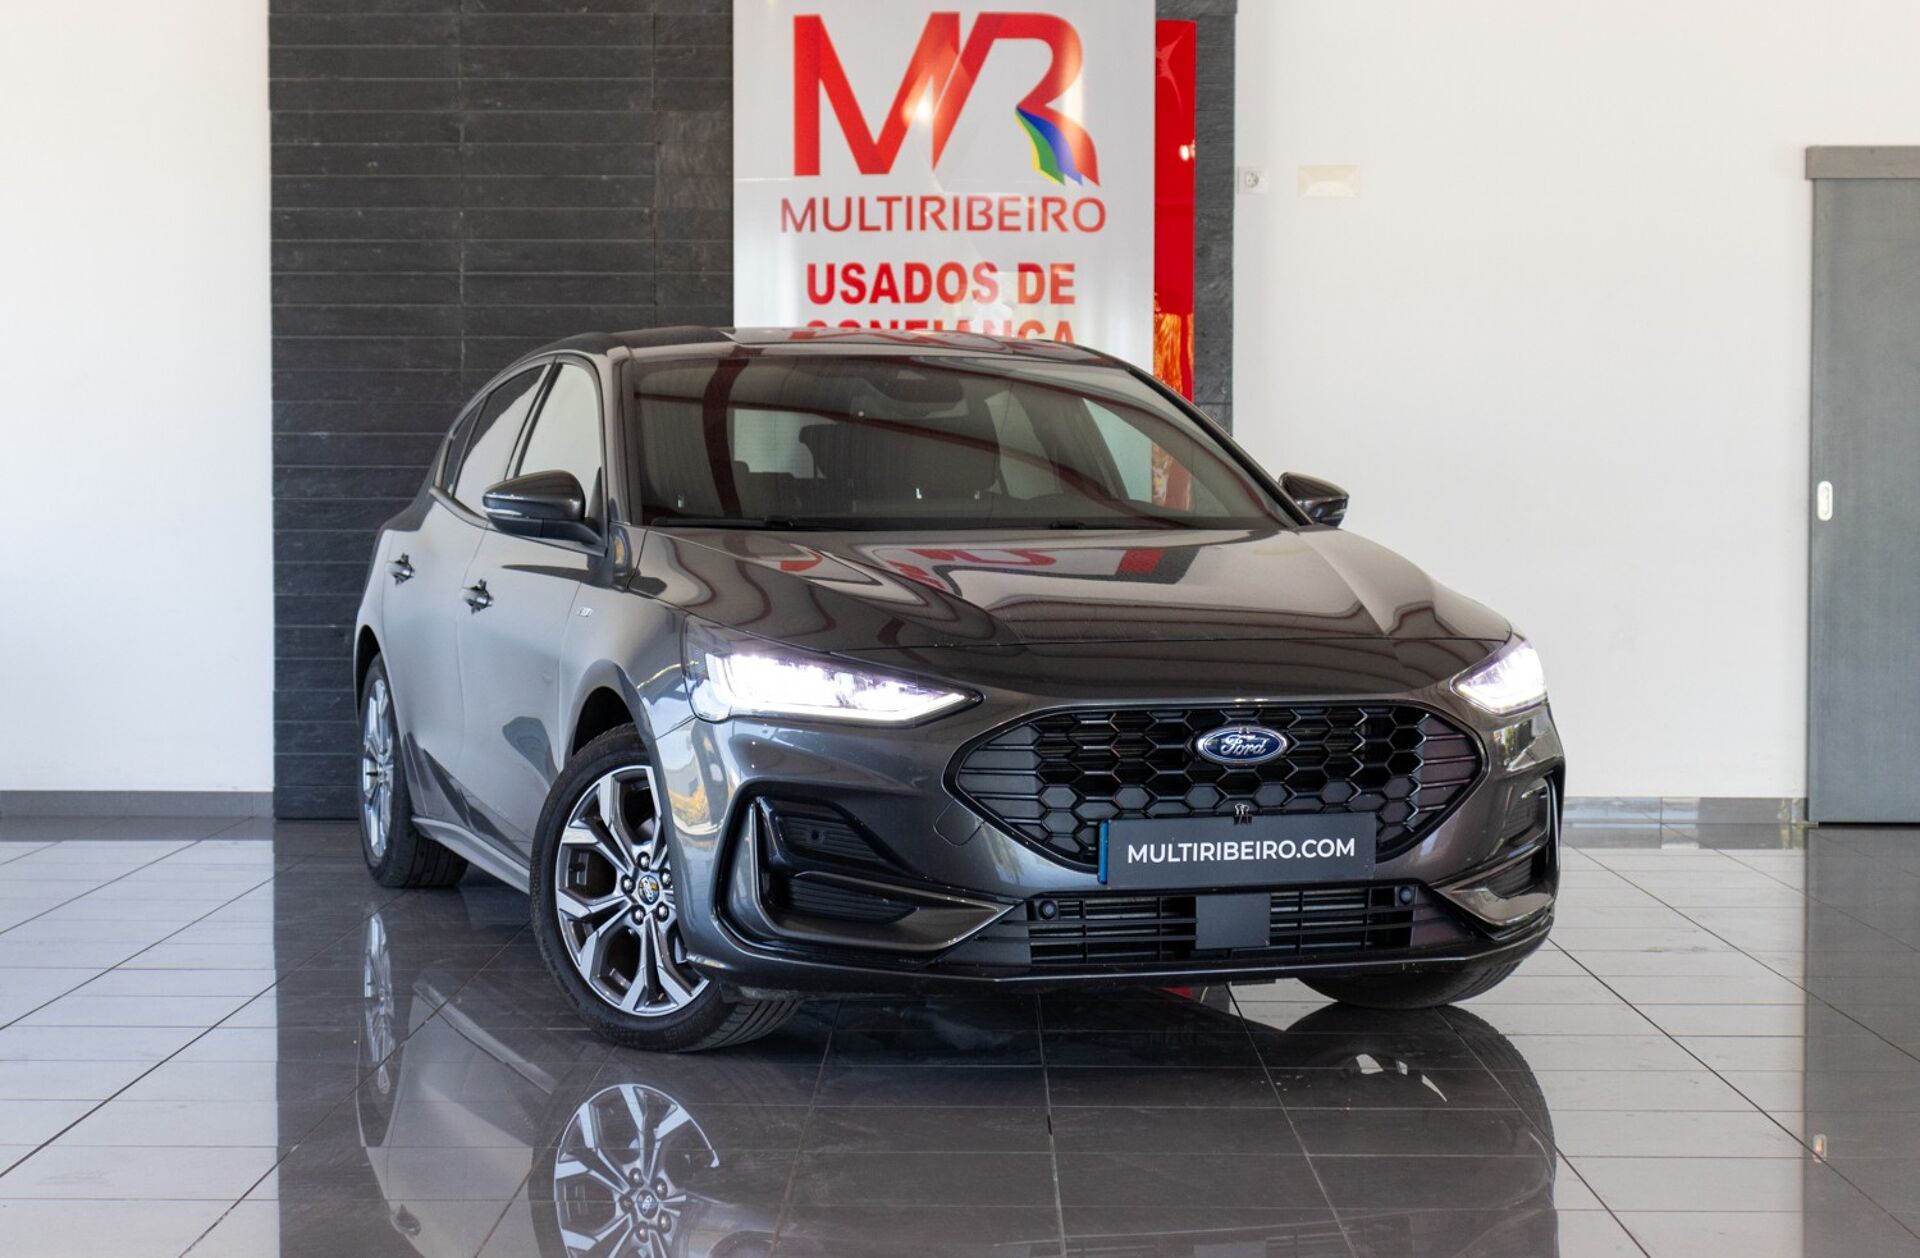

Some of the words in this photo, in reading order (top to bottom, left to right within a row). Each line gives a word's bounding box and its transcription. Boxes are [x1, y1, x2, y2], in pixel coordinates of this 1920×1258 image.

[793, 12, 1100, 186] MR
[806, 262, 1000, 305] USADOS
[1017, 262, 1076, 304] DE
[1220, 734, 1270, 756] Ford
[1127, 838, 1355, 863] MULTIRIBEIRO.COM
